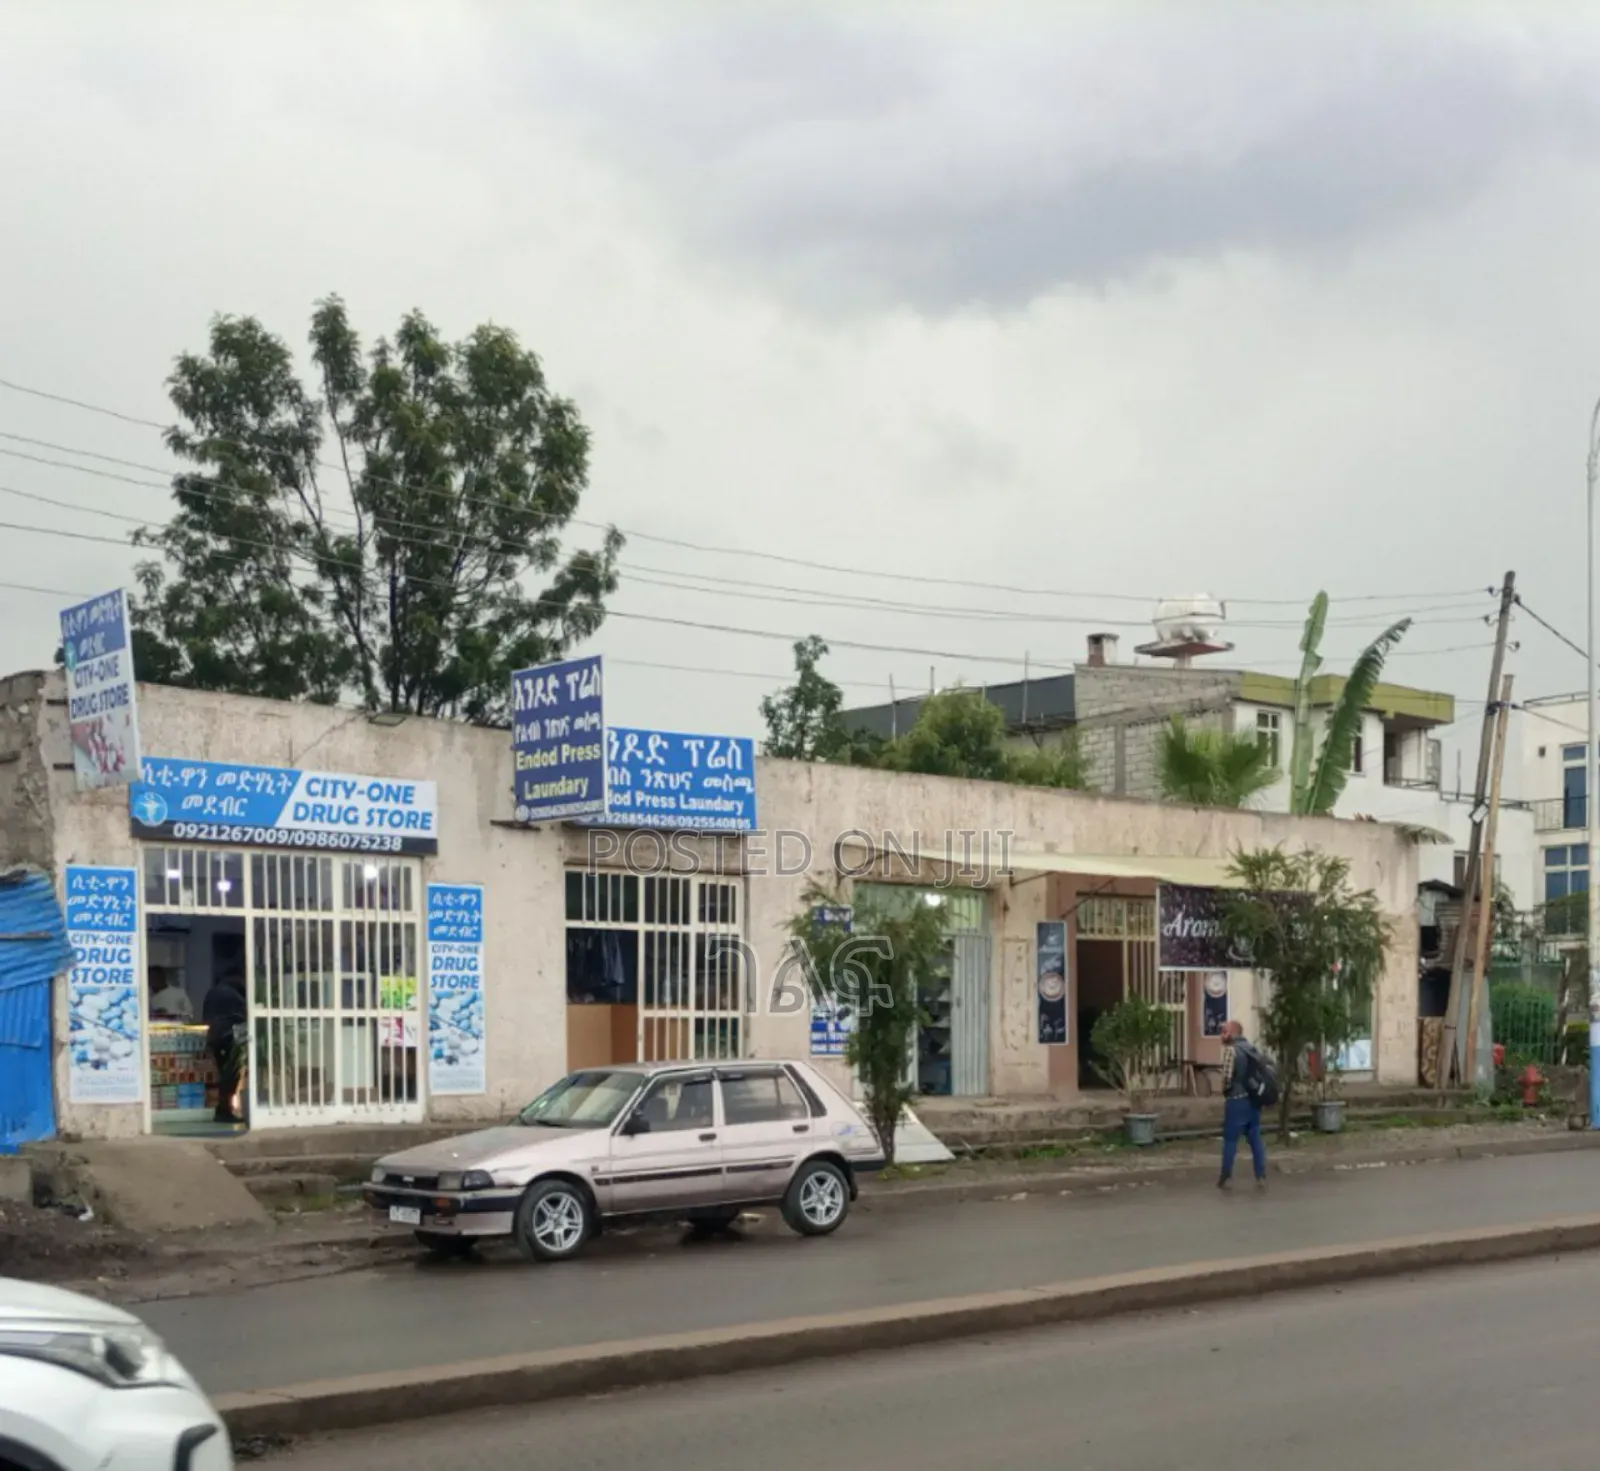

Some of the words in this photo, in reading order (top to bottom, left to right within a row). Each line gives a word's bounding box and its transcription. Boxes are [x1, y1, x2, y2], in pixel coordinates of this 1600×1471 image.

[75, 655, 119, 689] CITY-ONE
[71, 692, 97, 719] DRUG
[99, 683, 129, 711] STORE
[516, 745, 558, 771] Endod
[561, 743, 601, 764] Press
[606, 729, 669, 766] ንዶድ
[305, 777, 415, 805] CITY-ONE
[524, 775, 589, 801] Laundary
[181, 794, 248, 817] መደብር
[293, 802, 359, 825] DRUG
[365, 807, 432, 830] STORE
[635, 790, 676, 809] Press
[679, 792, 744, 816] Laundary
[173, 822, 403, 851] 0921267009/0986075238
[71, 933, 133, 945] CITY-ONE
[432, 943, 479, 954] CITY-ONE
[73, 947, 132, 964] DRUG
[432, 955, 478, 971] DRUG
[71, 967, 134, 984] STORE
[430, 974, 480, 989] STORE
